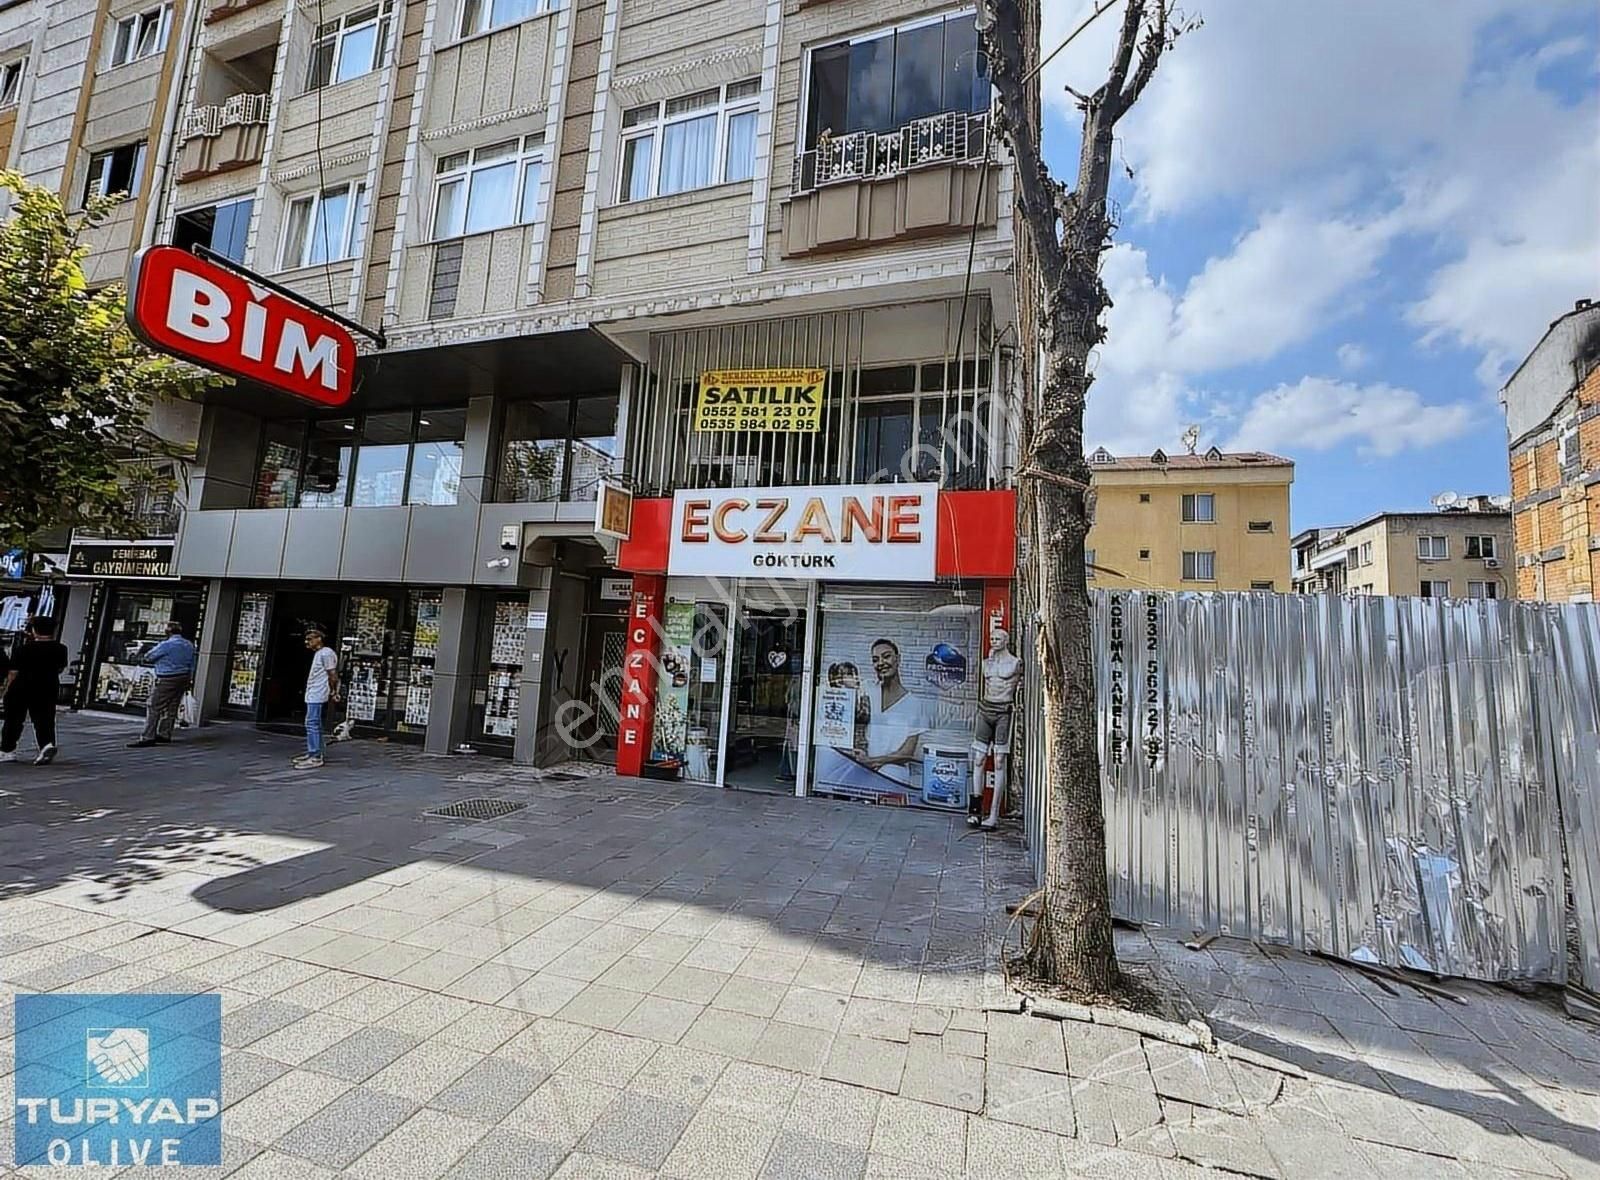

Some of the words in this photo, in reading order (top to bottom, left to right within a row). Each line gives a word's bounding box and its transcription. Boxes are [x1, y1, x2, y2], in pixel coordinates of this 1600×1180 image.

[166, 268, 338, 391] BİM
[702, 406, 736, 417] 0552
[741, 406, 767, 417] 581
[773, 406, 792, 417] 23
[797, 406, 816, 417] 07
[704, 386, 816, 405] SATILIK
[700, 419, 735, 429] 0535
[740, 419, 767, 430] 984
[772, 419, 790, 430] 02
[796, 419, 815, 430] 95
[681, 495, 921, 543] ECZANE
[93, 560, 169, 576] GAYRİMENKU
[753, 552, 836, 568] GÖKTÜRK
[1111, 595, 1124, 663] KORUMA
[1146, 595, 1158, 651] 0532
[625, 604, 647, 744] ECZANE
[1146, 661, 1158, 703] 562
[1146, 709, 1158, 735] 27
